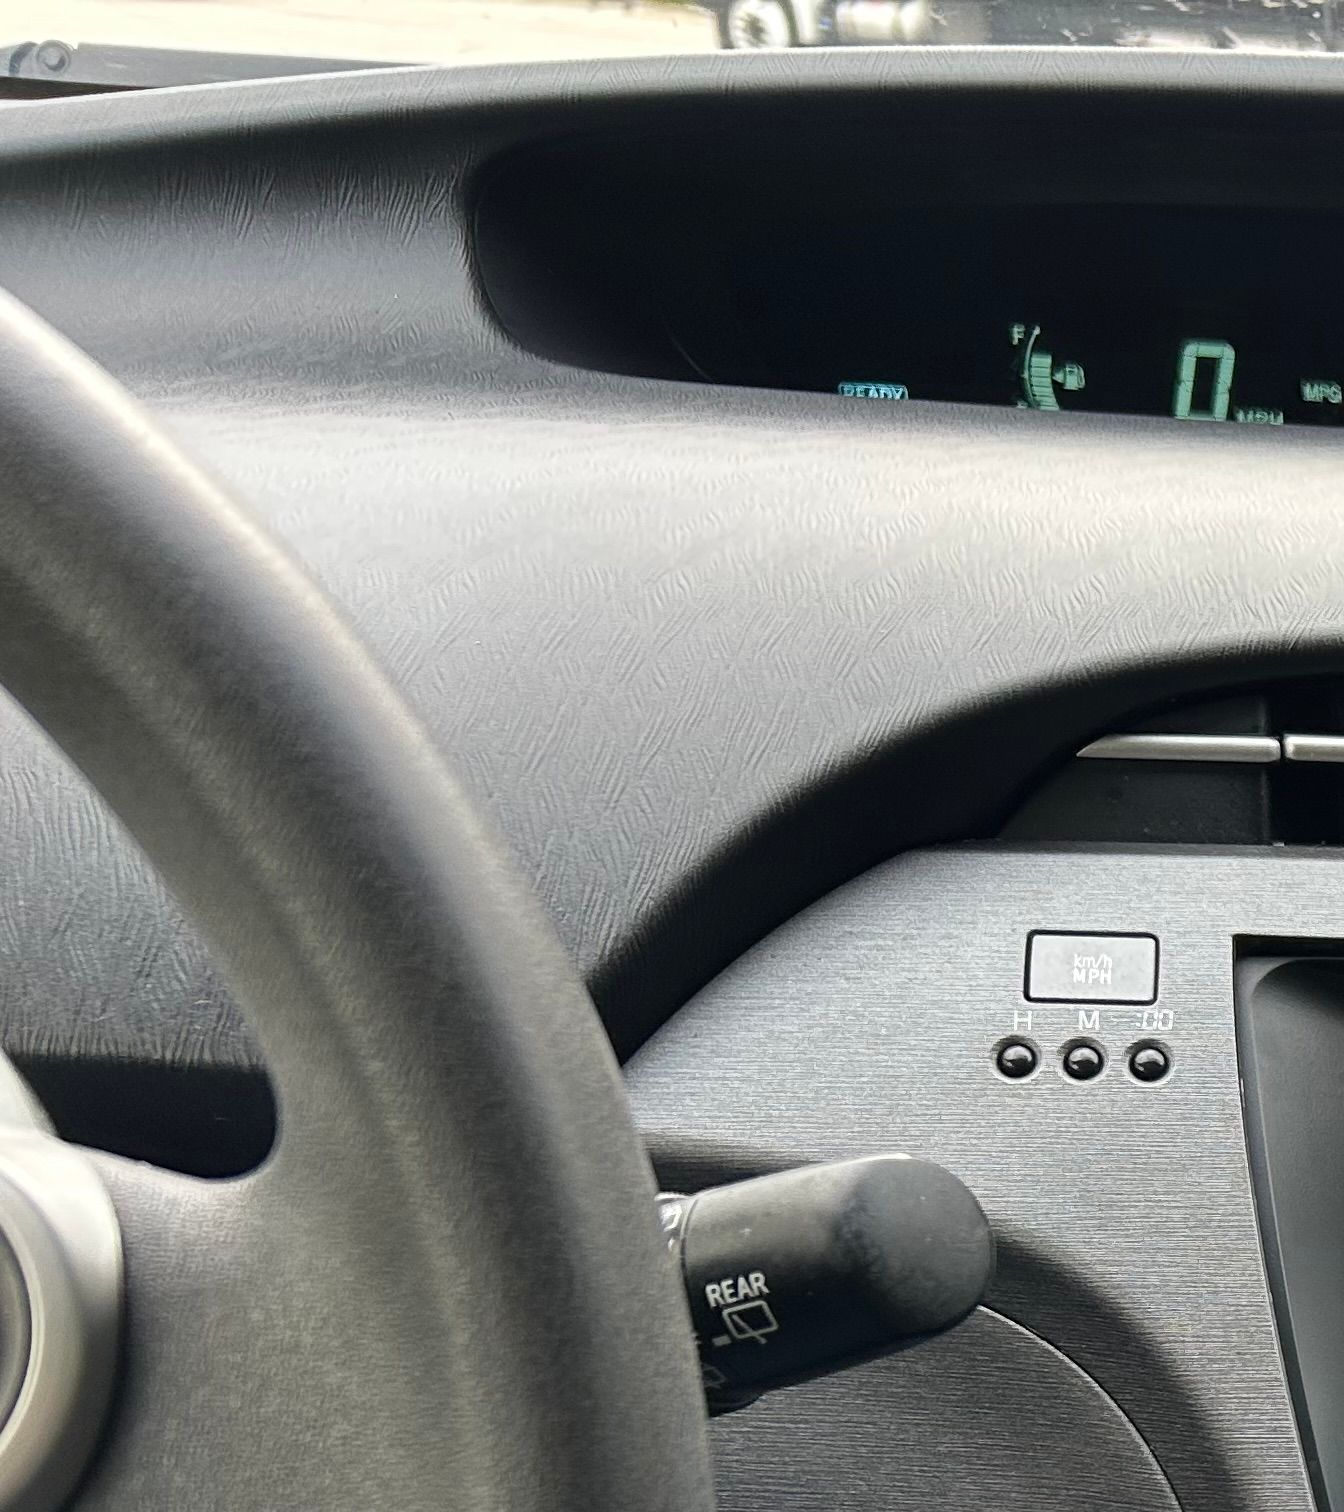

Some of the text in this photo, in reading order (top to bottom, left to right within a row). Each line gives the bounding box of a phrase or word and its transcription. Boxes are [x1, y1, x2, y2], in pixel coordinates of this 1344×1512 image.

[1073, 954, 1113, 968] km/h
[1073, 969, 1112, 984] MPH
[1013, 1010, 1032, 1030] H
[1078, 1010, 1100, 1030] M
[705, 1271, 770, 1308] REAR
